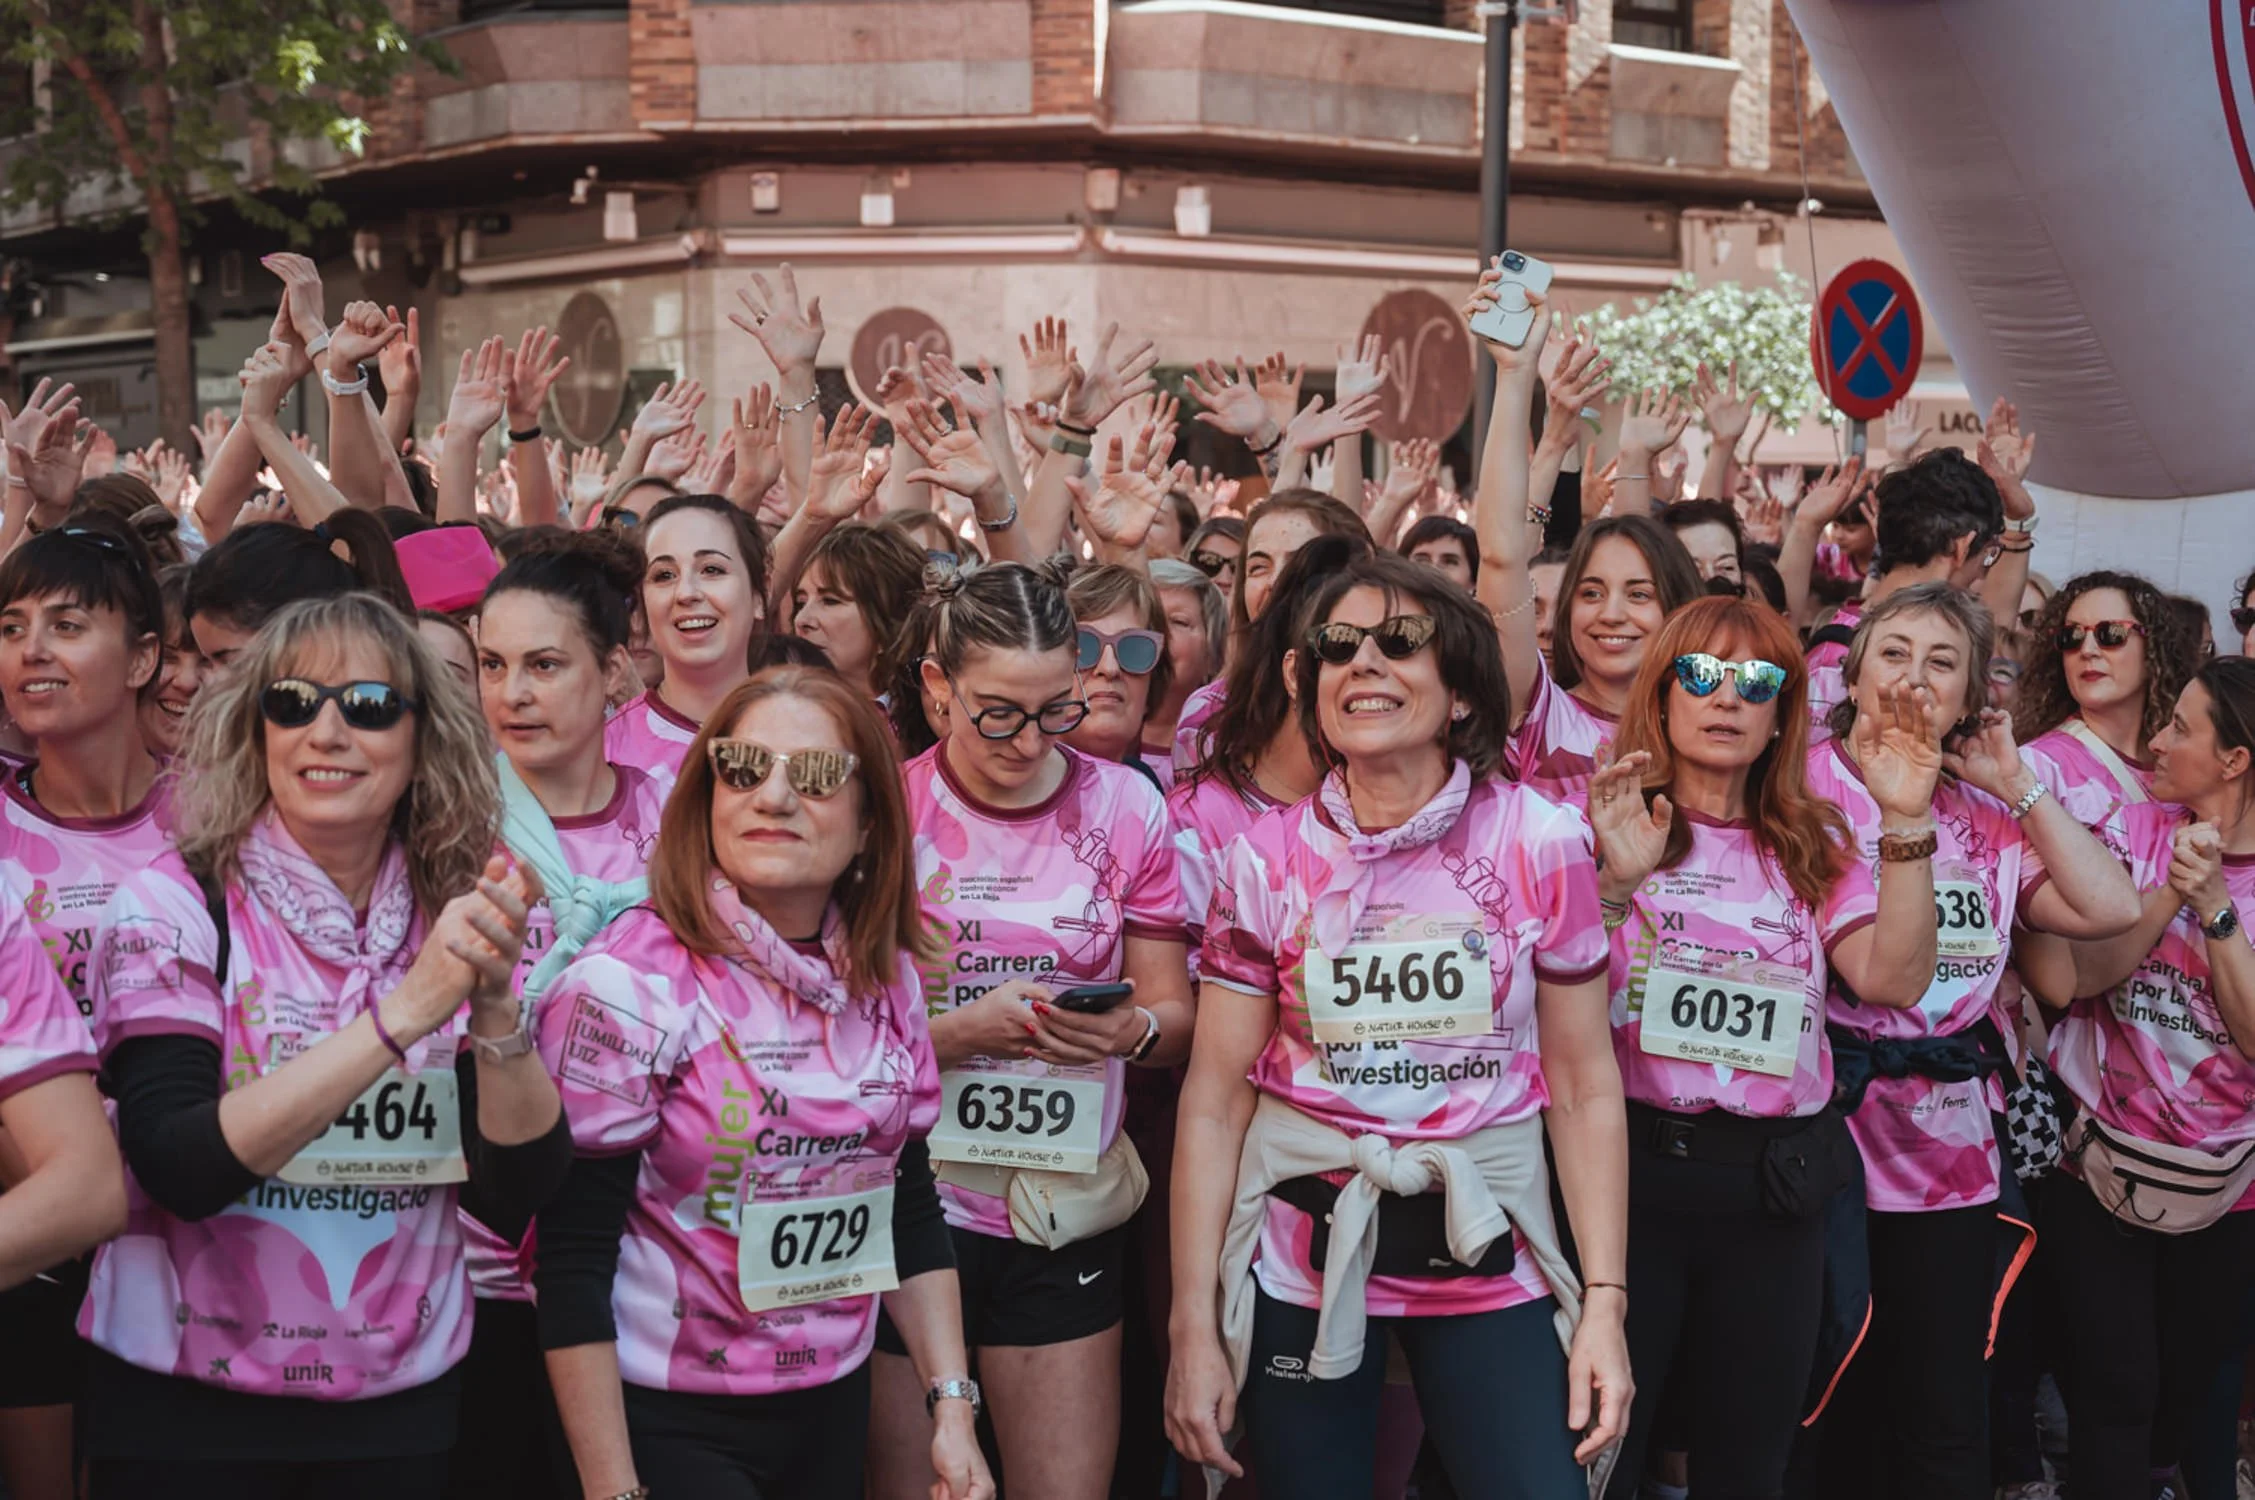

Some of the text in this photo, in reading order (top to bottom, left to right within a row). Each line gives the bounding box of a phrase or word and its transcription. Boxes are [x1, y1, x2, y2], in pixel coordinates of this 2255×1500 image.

[1661, 911, 1684, 931] XI
[1934, 889, 1986, 929] 638
[63, 928, 92, 954] XI
[957, 920, 981, 942] XI
[955, 950, 1055, 973] Carrera
[1332, 951, 1464, 1007] 5466
[2131, 979, 2167, 999] por
[1671, 984, 1777, 1042] 6031
[2129, 1001, 2234, 1045] Investigac
[1329, 1054, 1500, 1090] Investigación
[314, 1081, 437, 1141] 464
[758, 1085, 789, 1117] XI
[957, 1082, 1076, 1138] 6359
[704, 1079, 755, 1229] mujer
[755, 1127, 863, 1157] Carrera
[256, 1184, 430, 1220] Investigació
[771, 1204, 870, 1269] 6729
